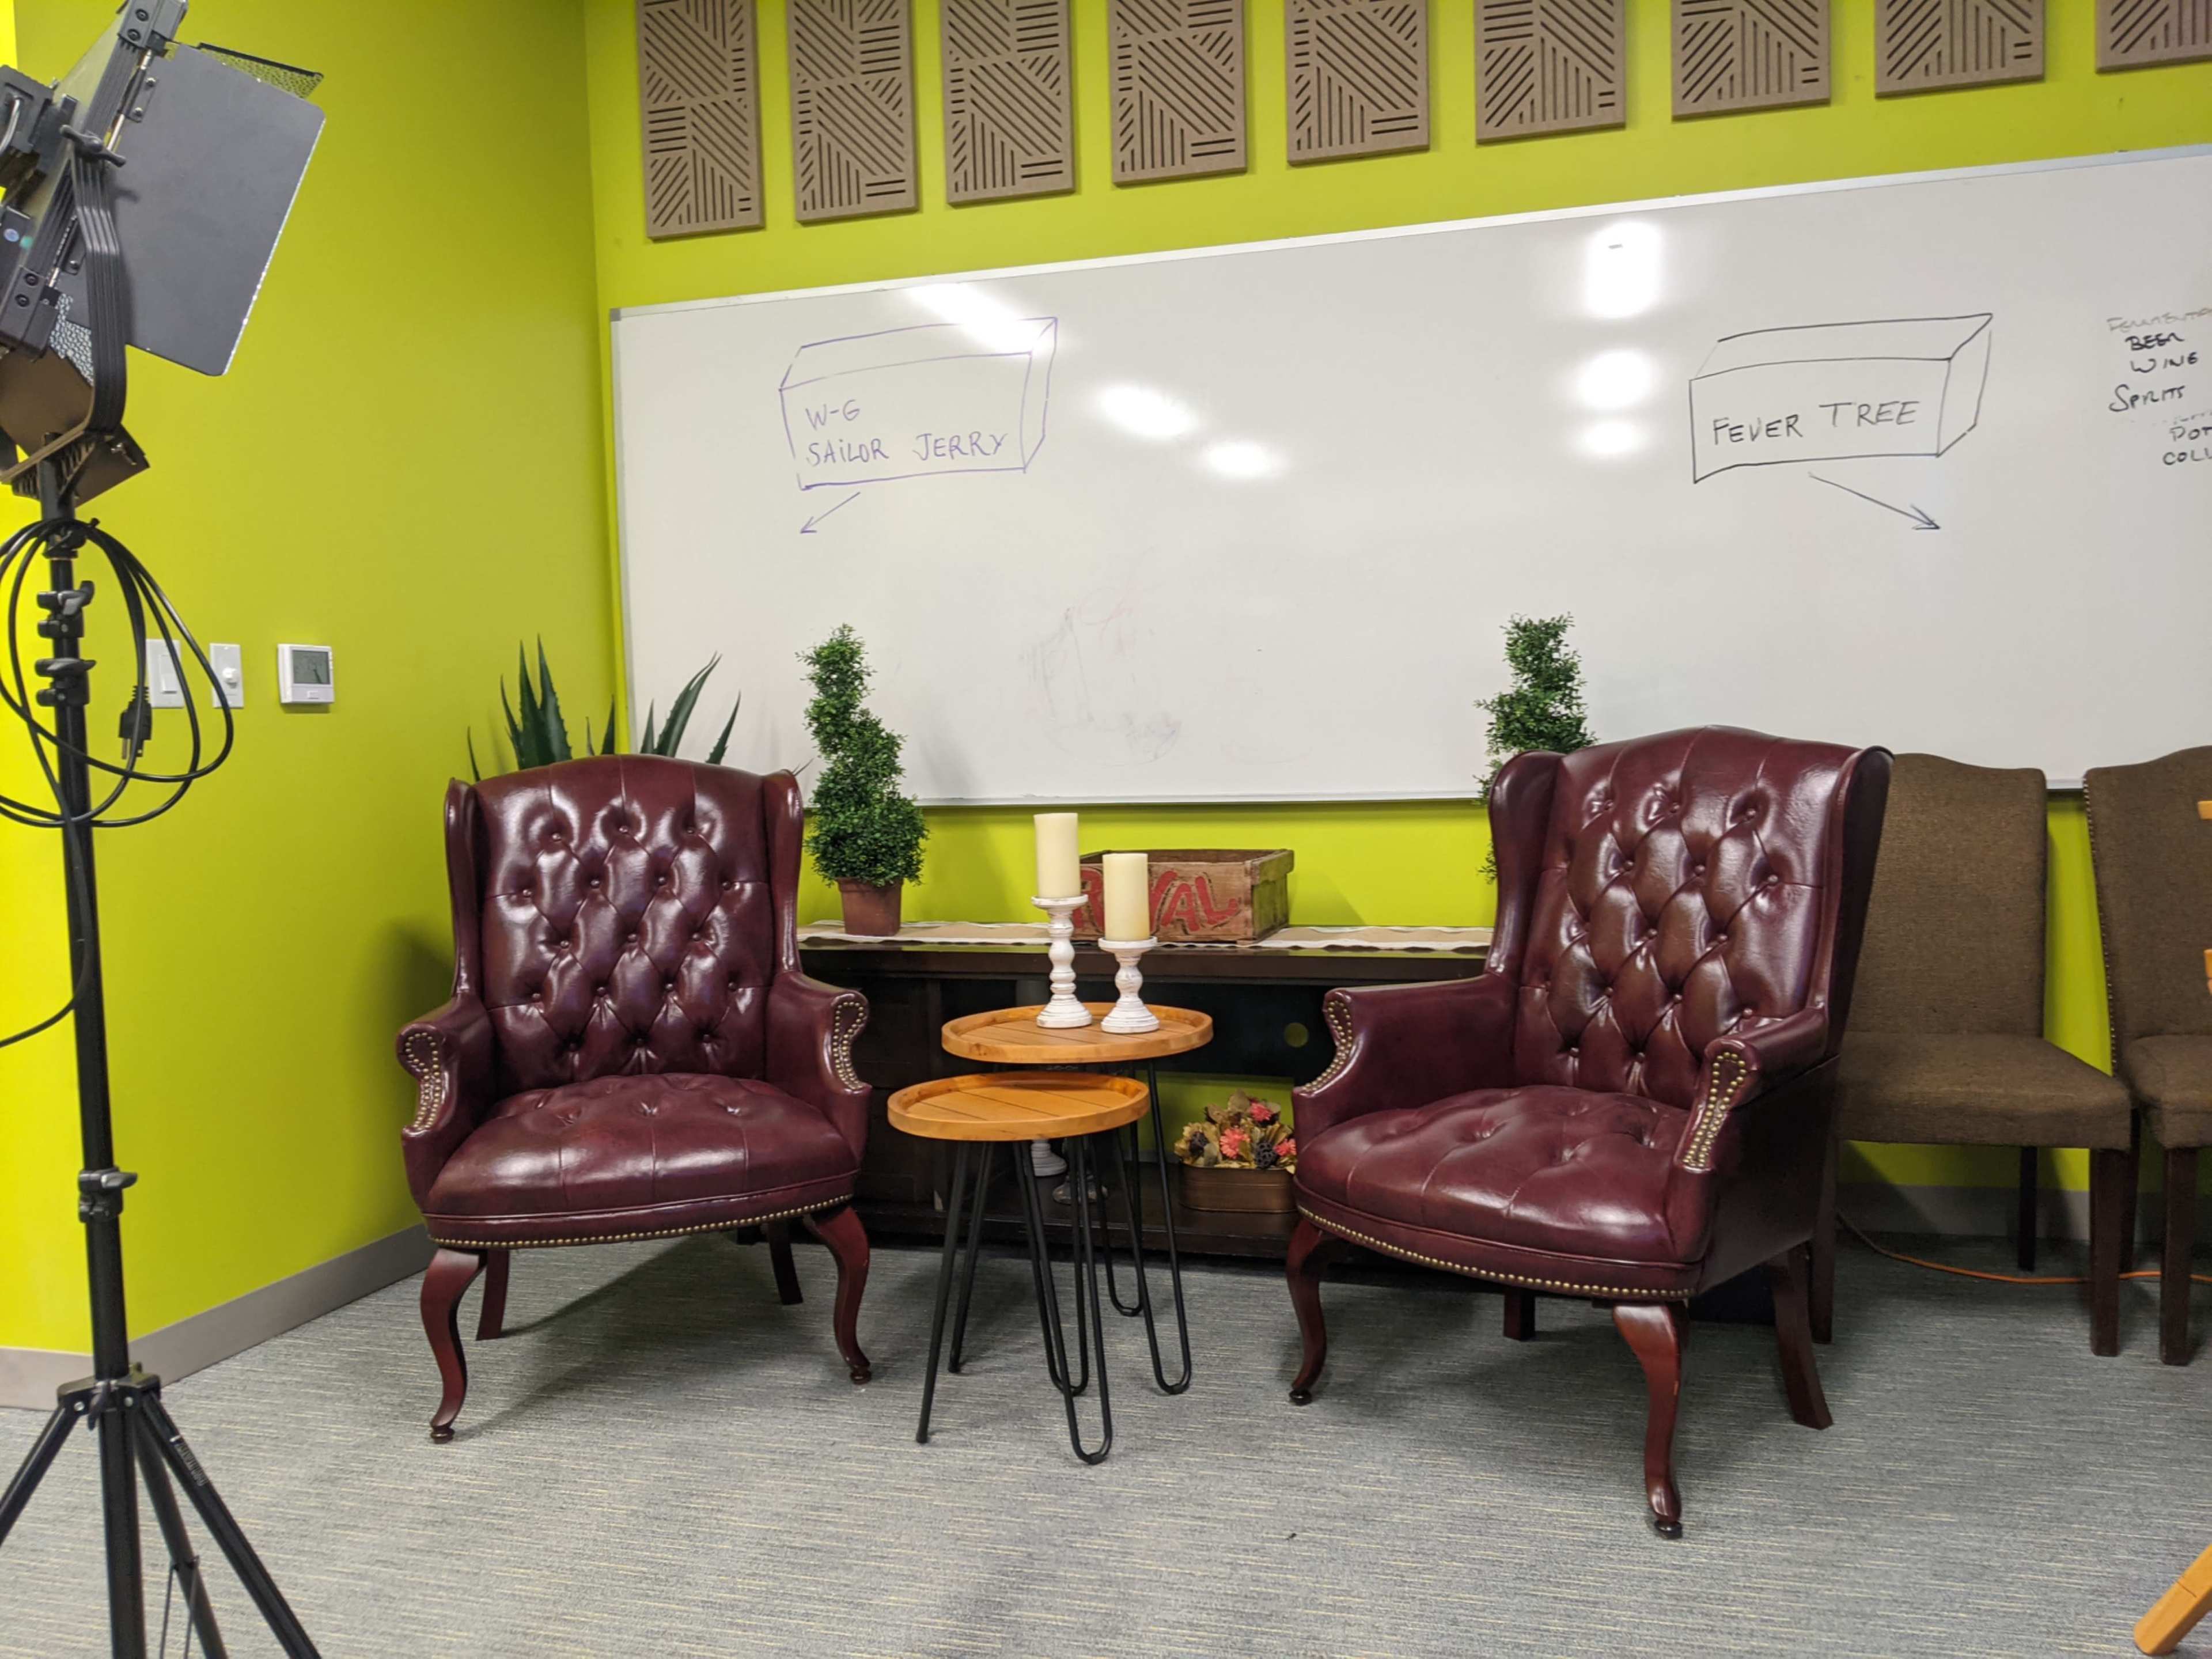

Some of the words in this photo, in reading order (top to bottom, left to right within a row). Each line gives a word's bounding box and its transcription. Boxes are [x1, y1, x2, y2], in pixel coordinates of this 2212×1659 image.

[2124, 331, 2186, 351] BEER
[2130, 351, 2198, 373] WINE
[805, 399, 861, 431] W-G
[1713, 413, 1803, 446] FEVER
[1819, 401, 1919, 426] TREE
[912, 431, 1009, 461] JERRY
